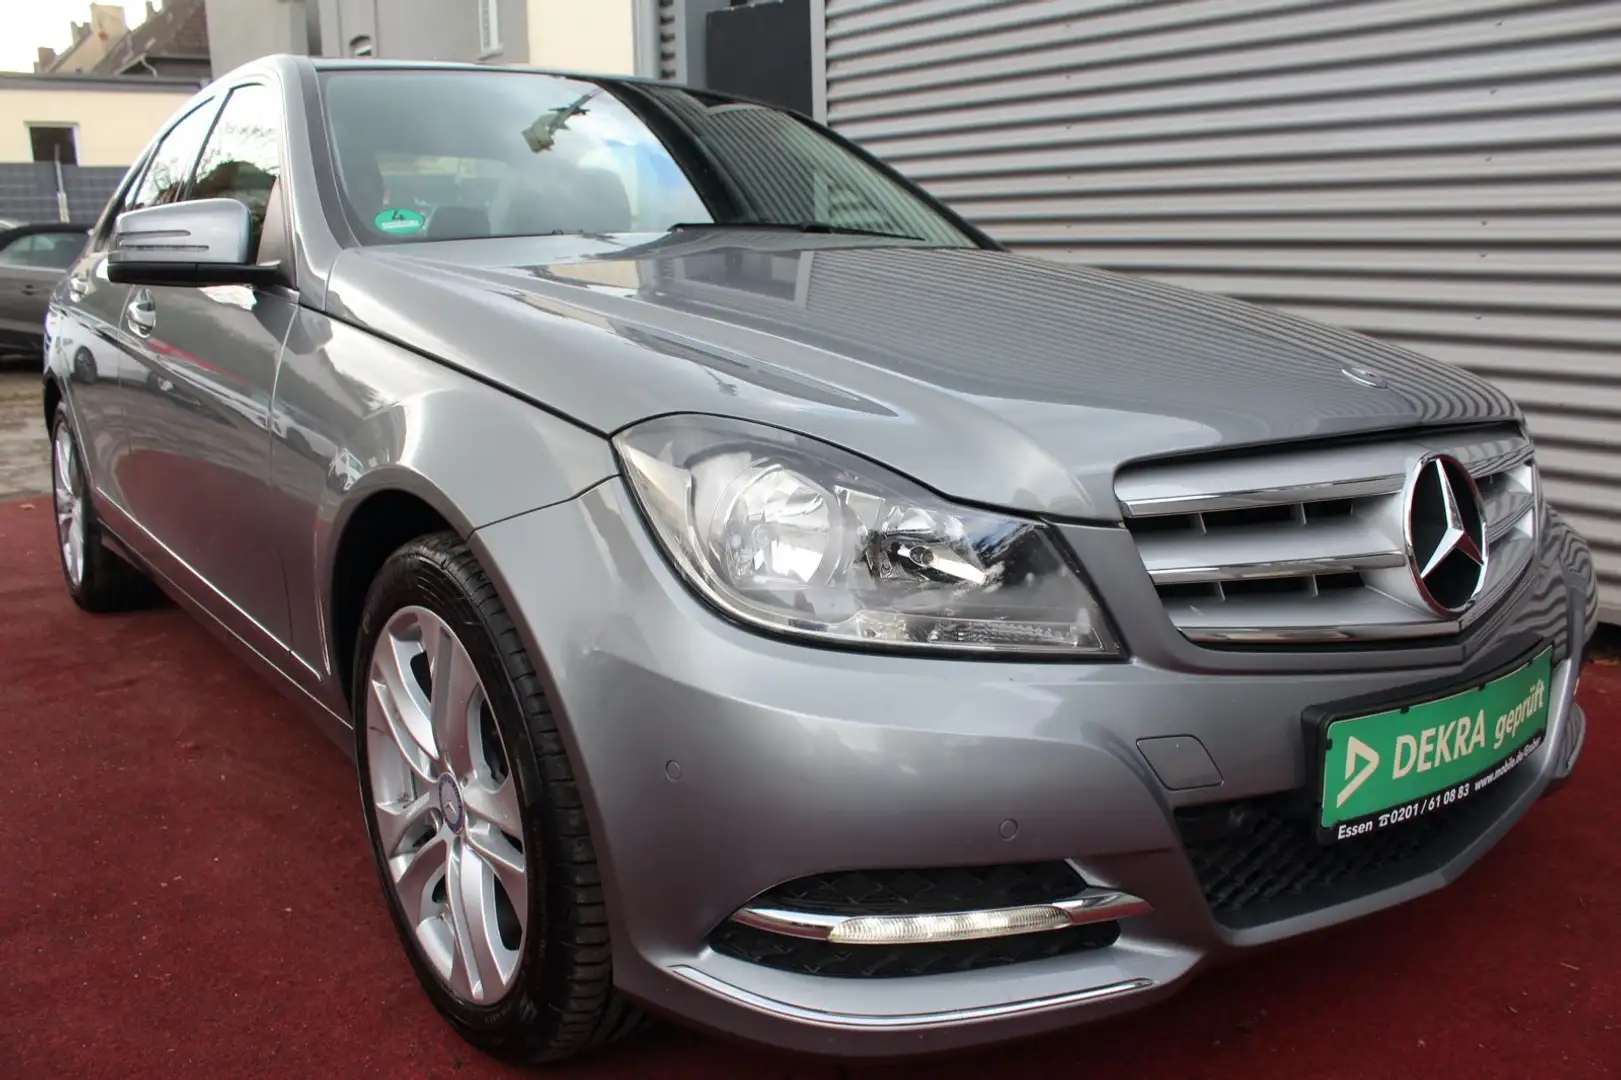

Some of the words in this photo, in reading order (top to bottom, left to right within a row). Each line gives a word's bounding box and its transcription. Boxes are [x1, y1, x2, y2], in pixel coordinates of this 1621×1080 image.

[1392, 709, 1486, 780] DEKRA
[1493, 678, 1545, 749] geprüft
[1338, 821, 1373, 839] Essen
